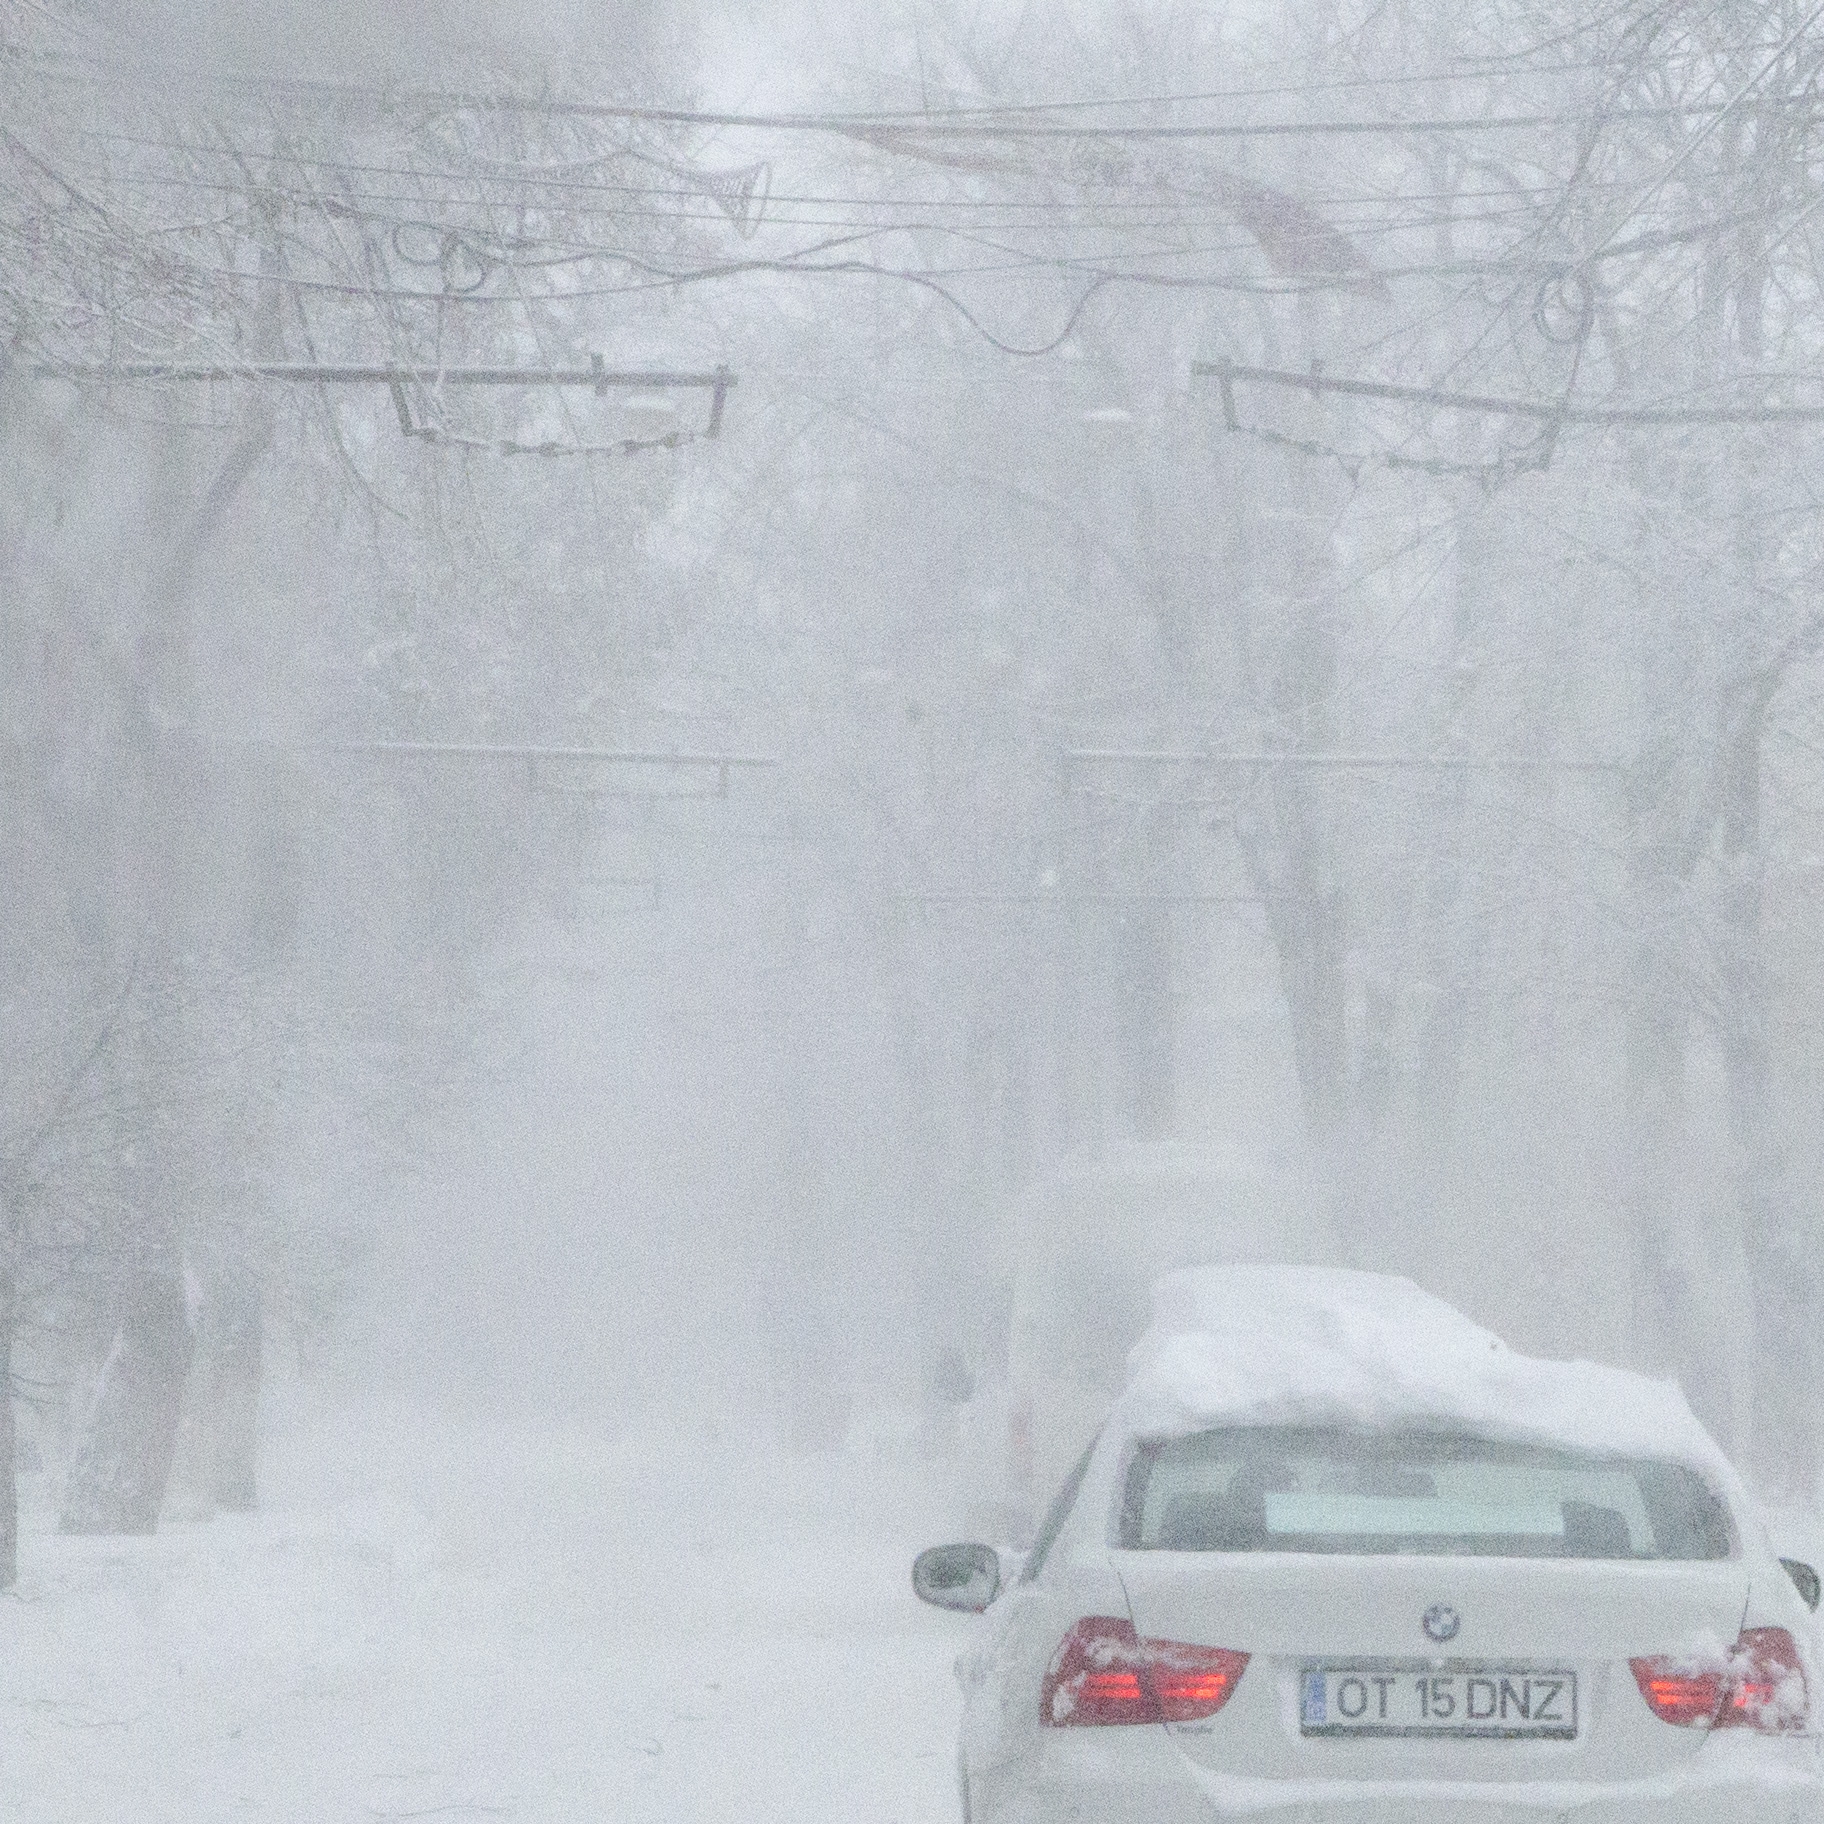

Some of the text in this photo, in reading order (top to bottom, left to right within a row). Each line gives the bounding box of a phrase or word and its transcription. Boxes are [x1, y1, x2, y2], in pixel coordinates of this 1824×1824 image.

[1337, 1677, 1396, 1718] OT
[1416, 1676, 1456, 1719] 15
[1467, 1677, 1564, 1721] DNZ
